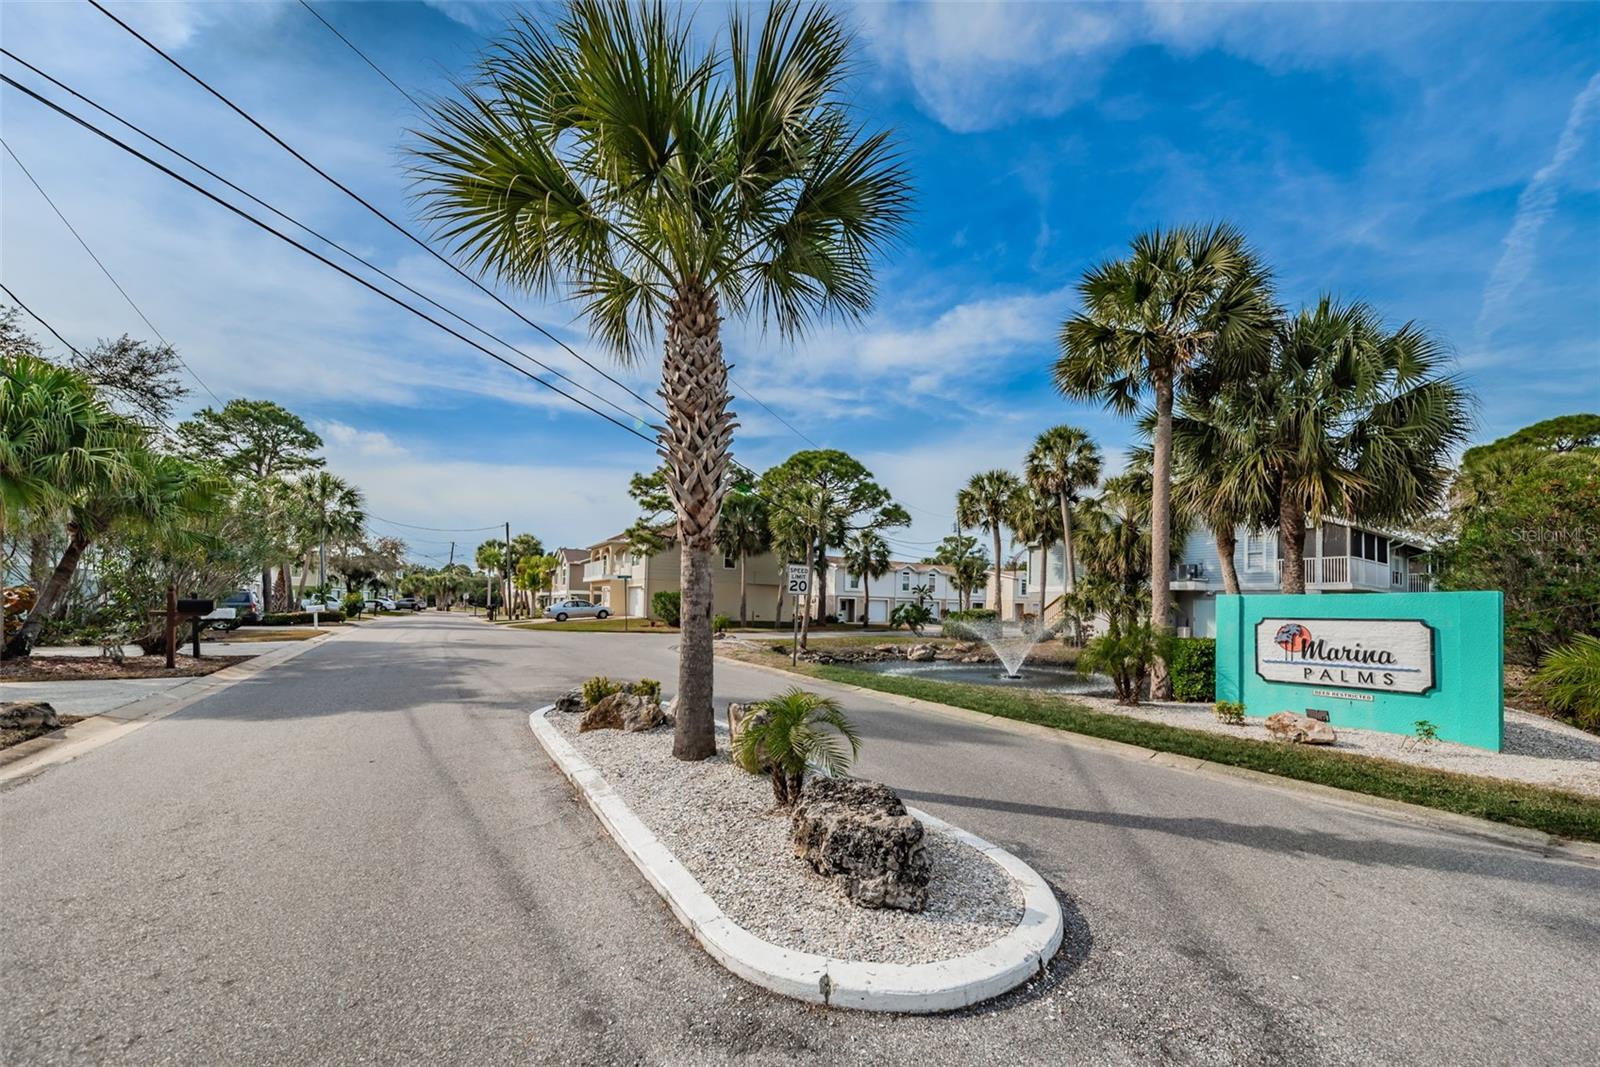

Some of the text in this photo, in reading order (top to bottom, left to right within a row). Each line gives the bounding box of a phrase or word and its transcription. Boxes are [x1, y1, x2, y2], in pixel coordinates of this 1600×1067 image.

[789, 580, 807, 592] 20
[1301, 638, 1396, 665] Marina
[1303, 667, 1395, 686] PALMS
[1331, 691, 1372, 700] RESTRICTED
